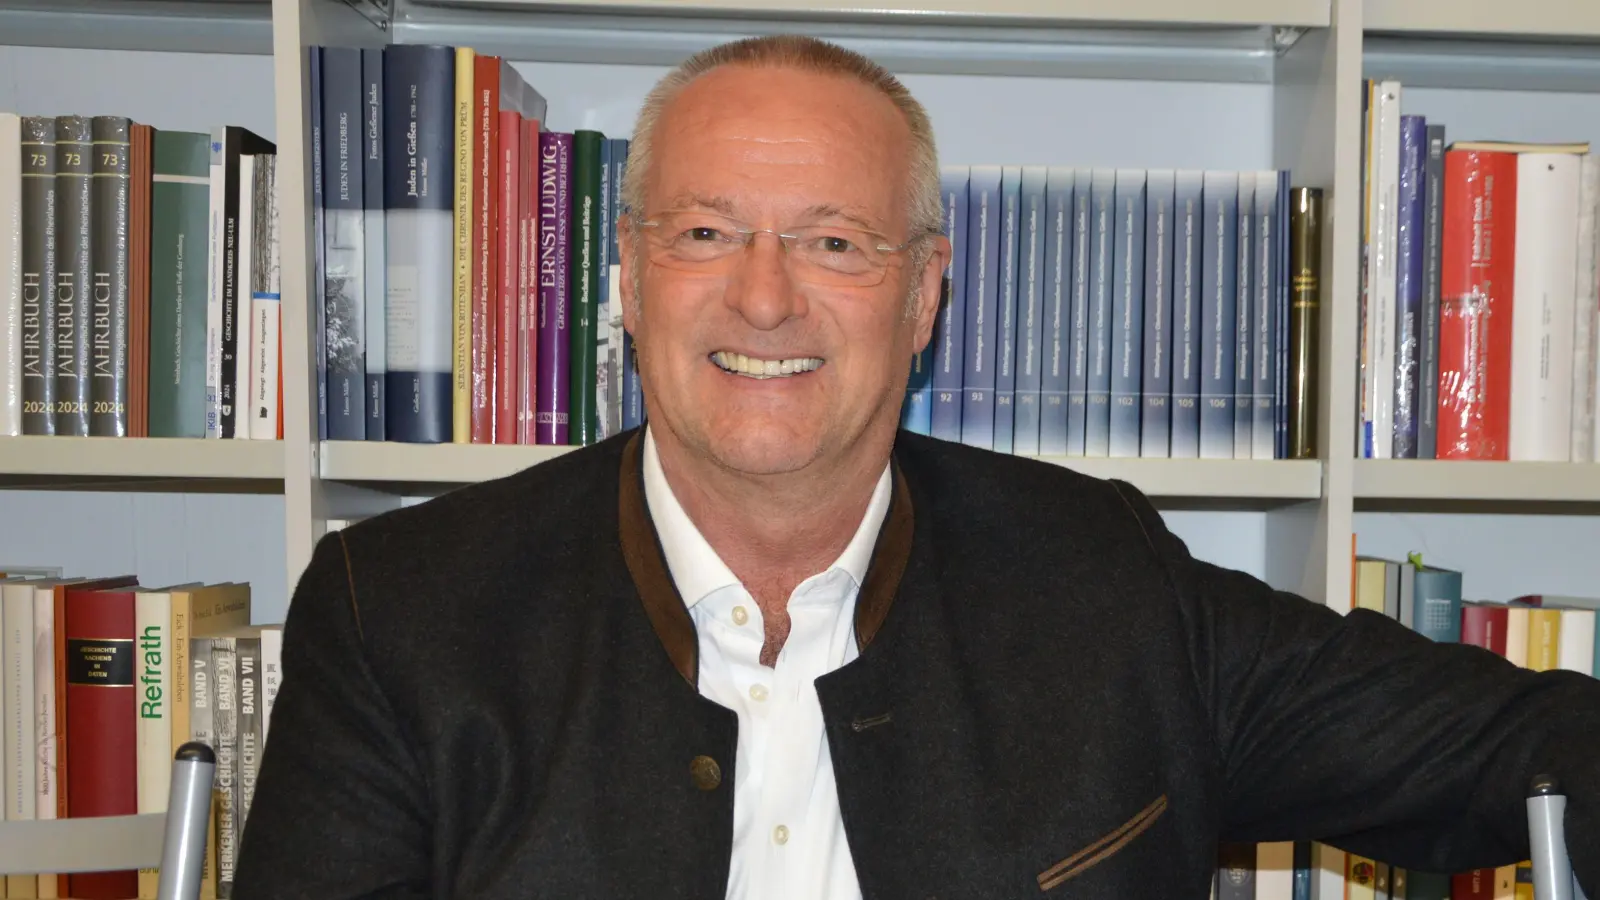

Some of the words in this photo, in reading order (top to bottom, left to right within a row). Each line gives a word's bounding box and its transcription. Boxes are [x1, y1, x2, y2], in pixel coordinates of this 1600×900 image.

[369, 84, 379, 105] Juden
[459, 102, 468, 127] PRÜM
[407, 122, 416, 155] Gießen
[31, 154, 48, 166] 73
[65, 154, 81, 166] 73
[102, 154, 118, 166] 73
[341, 161, 348, 170] IN
[408, 158, 416, 167] in
[341, 173, 349, 200] JUDEN
[407, 170, 418, 197] Juden
[543, 145, 557, 218] LUDWIG
[46, 190, 54, 235] Rheinlandes
[582, 196, 591, 225] Beiträge
[46, 236, 54, 250] des
[541, 221, 556, 287] ERNST
[581, 242, 590, 269] Quellen
[46, 252, 55, 317] Kirchengeschichte
[81, 252, 89, 317] Kirchengeschichte
[117, 252, 125, 317] Kirchengeschichte
[226, 288, 232, 297] IM
[557, 265, 565, 329] GROSSHERZOG
[25, 272, 44, 378] JAHRBUCH
[59, 272, 78, 378] JAHRBUCH
[95, 272, 114, 378] JAHRBUCH
[46, 318, 55, 366] Evangelische
[81, 318, 89, 366] Evangelische
[117, 318, 125, 366] Evangelische
[46, 368, 54, 378] für
[24, 401, 54, 414] 2024
[58, 401, 88, 414] 2024
[94, 401, 124, 414] 2024
[940, 394, 952, 402] 92
[971, 393, 983, 401] 93
[999, 396, 1010, 405] 94
[1118, 397, 1133, 406] 102
[1149, 398, 1164, 406] 104
[1178, 399, 1194, 407] 105
[1210, 399, 1225, 408] 106
[140, 626, 162, 718] Refrath
[194, 660, 206, 668] V
[219, 658, 230, 670] VI
[242, 657, 253, 674] VII
[195, 672, 206, 708] BAND
[219, 675, 231, 710] BAND
[242, 678, 254, 714] BAND
[219, 734, 232, 809] GESCHICHTE
[220, 814, 233, 882] MERKENER
